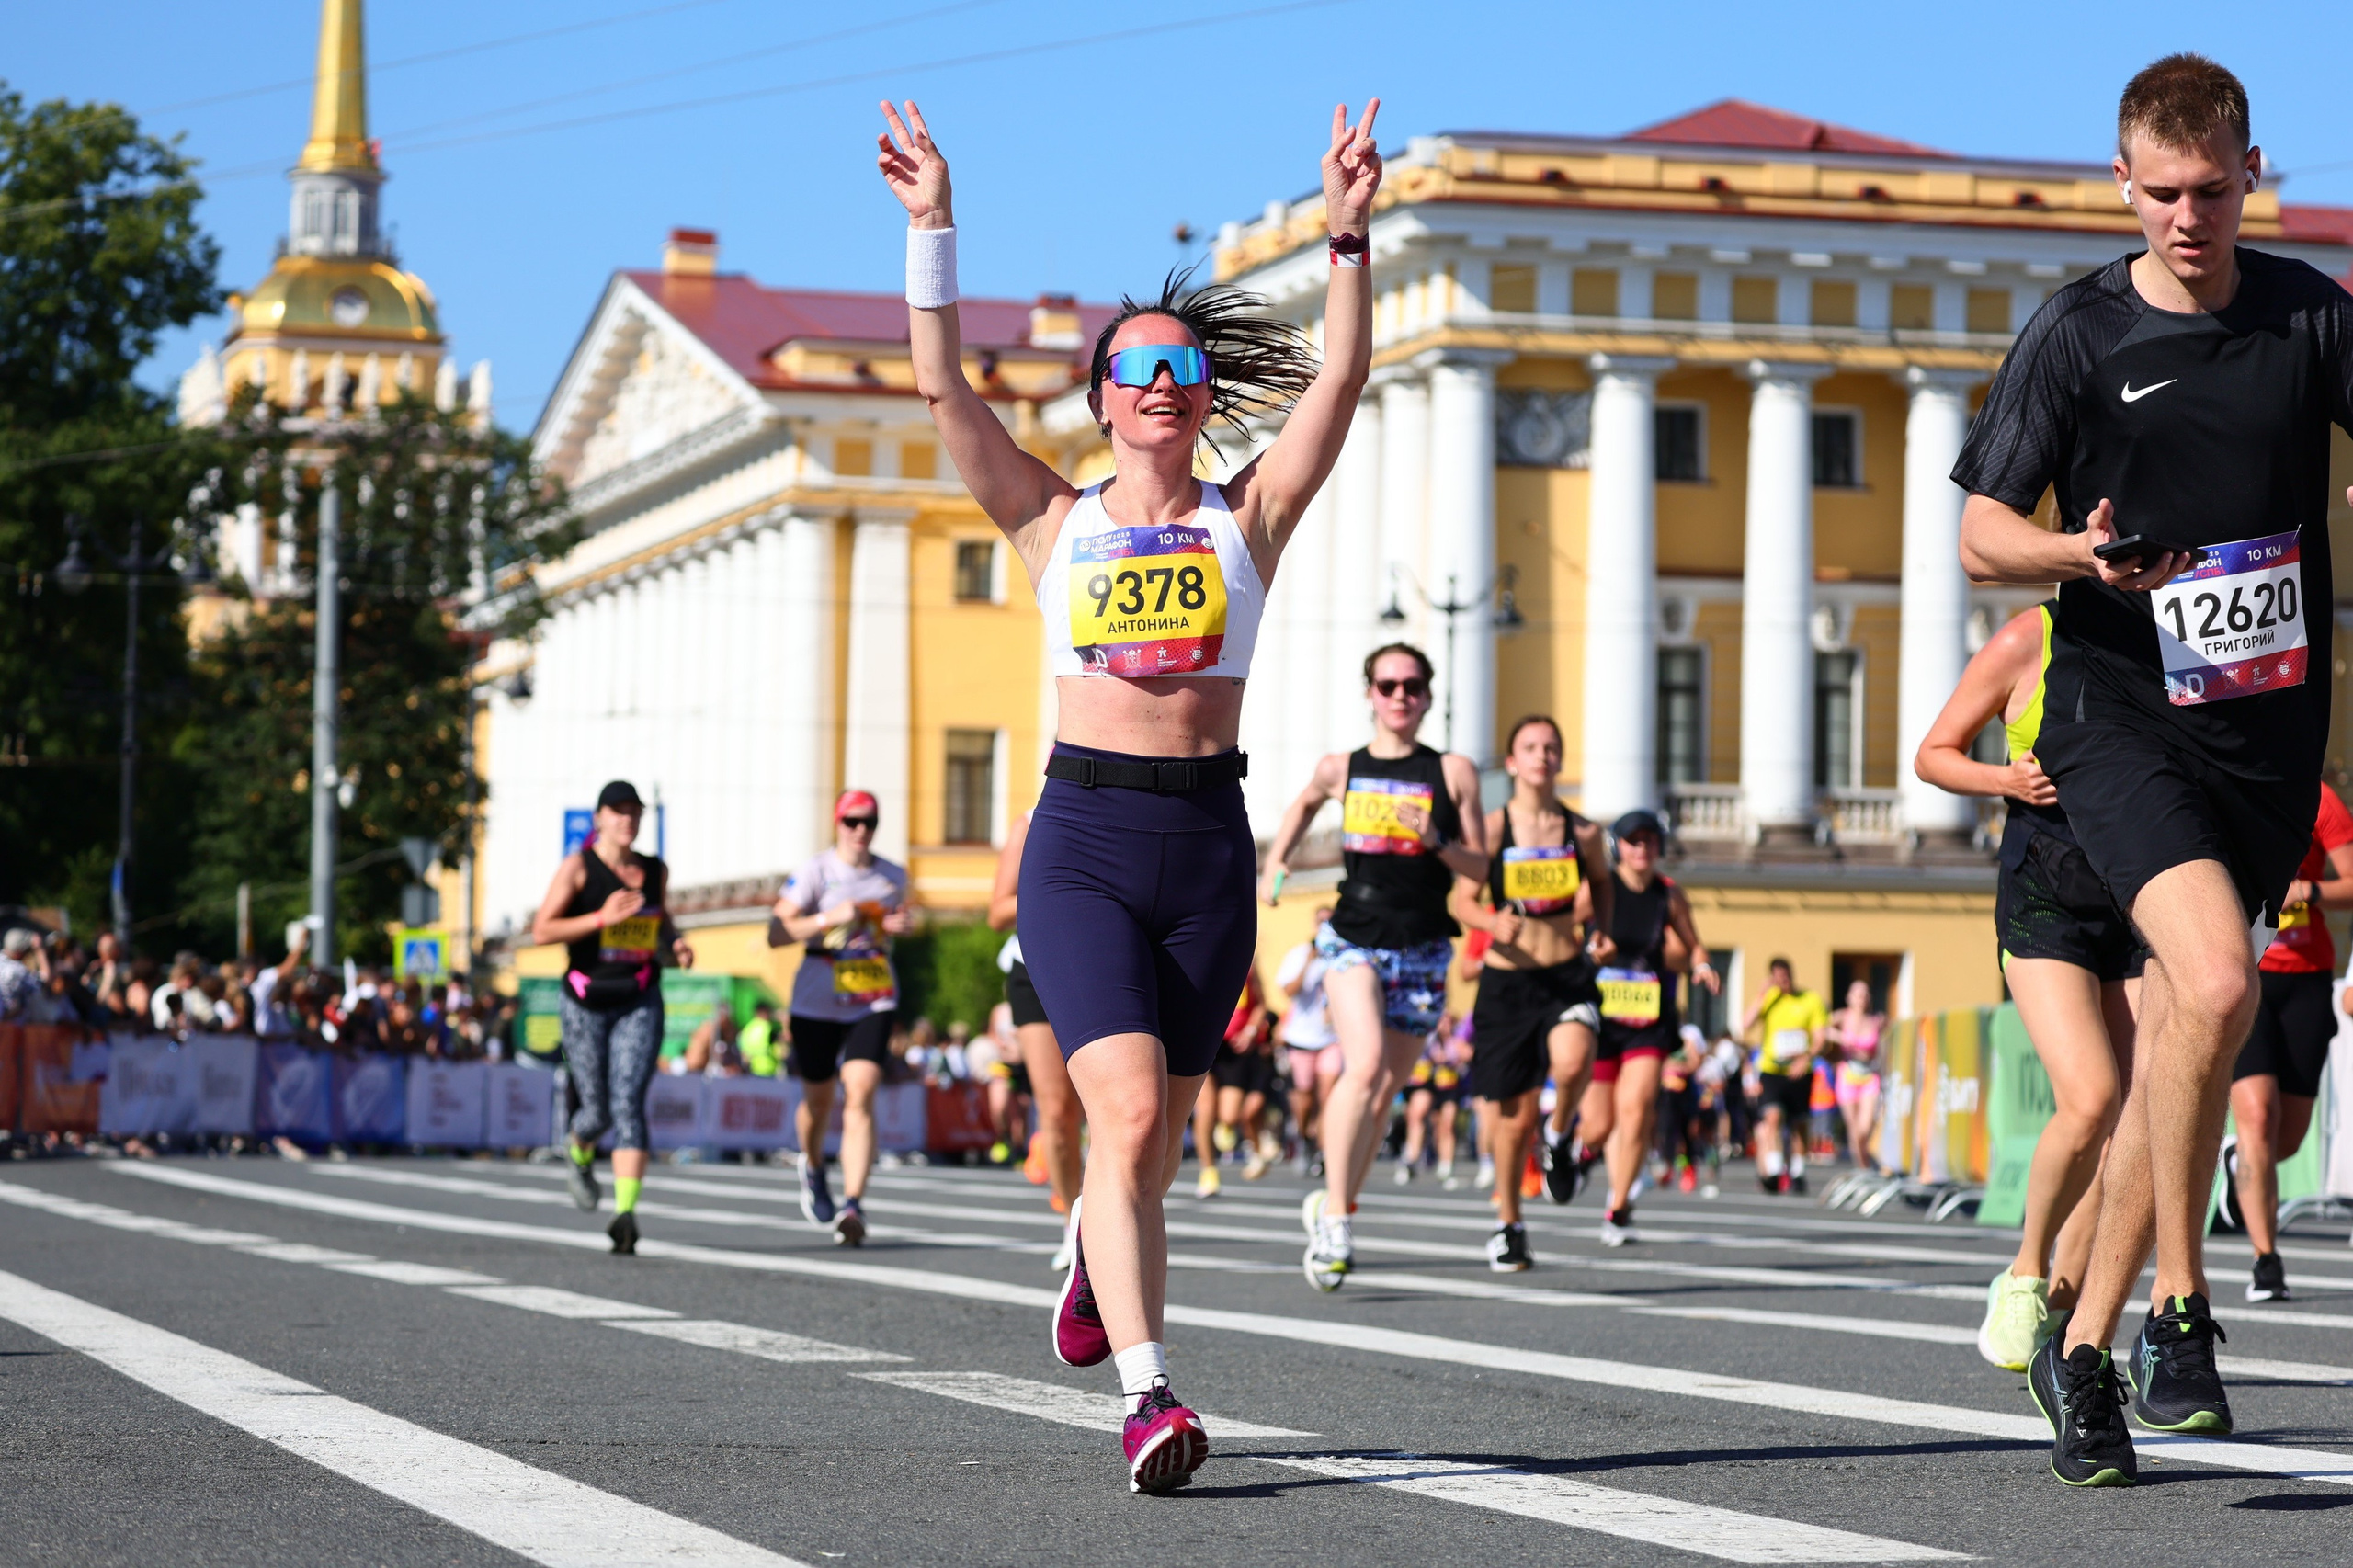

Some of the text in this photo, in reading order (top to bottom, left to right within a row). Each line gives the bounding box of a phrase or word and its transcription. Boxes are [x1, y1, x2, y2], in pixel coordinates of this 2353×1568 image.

[1090, 539, 1131, 554] МАРАФОН
[1157, 532, 1195, 545] 10 КМ
[2246, 544, 2282, 562] 10 КМ
[2196, 557, 2222, 570] ФОН
[1087, 565, 1207, 618] 9378
[2164, 577, 2298, 642] 12620
[1107, 616, 1190, 634] АНТОНИНА
[2204, 629, 2275, 656] ГРИГОРИЙ
[2185, 673, 2205, 699] D
